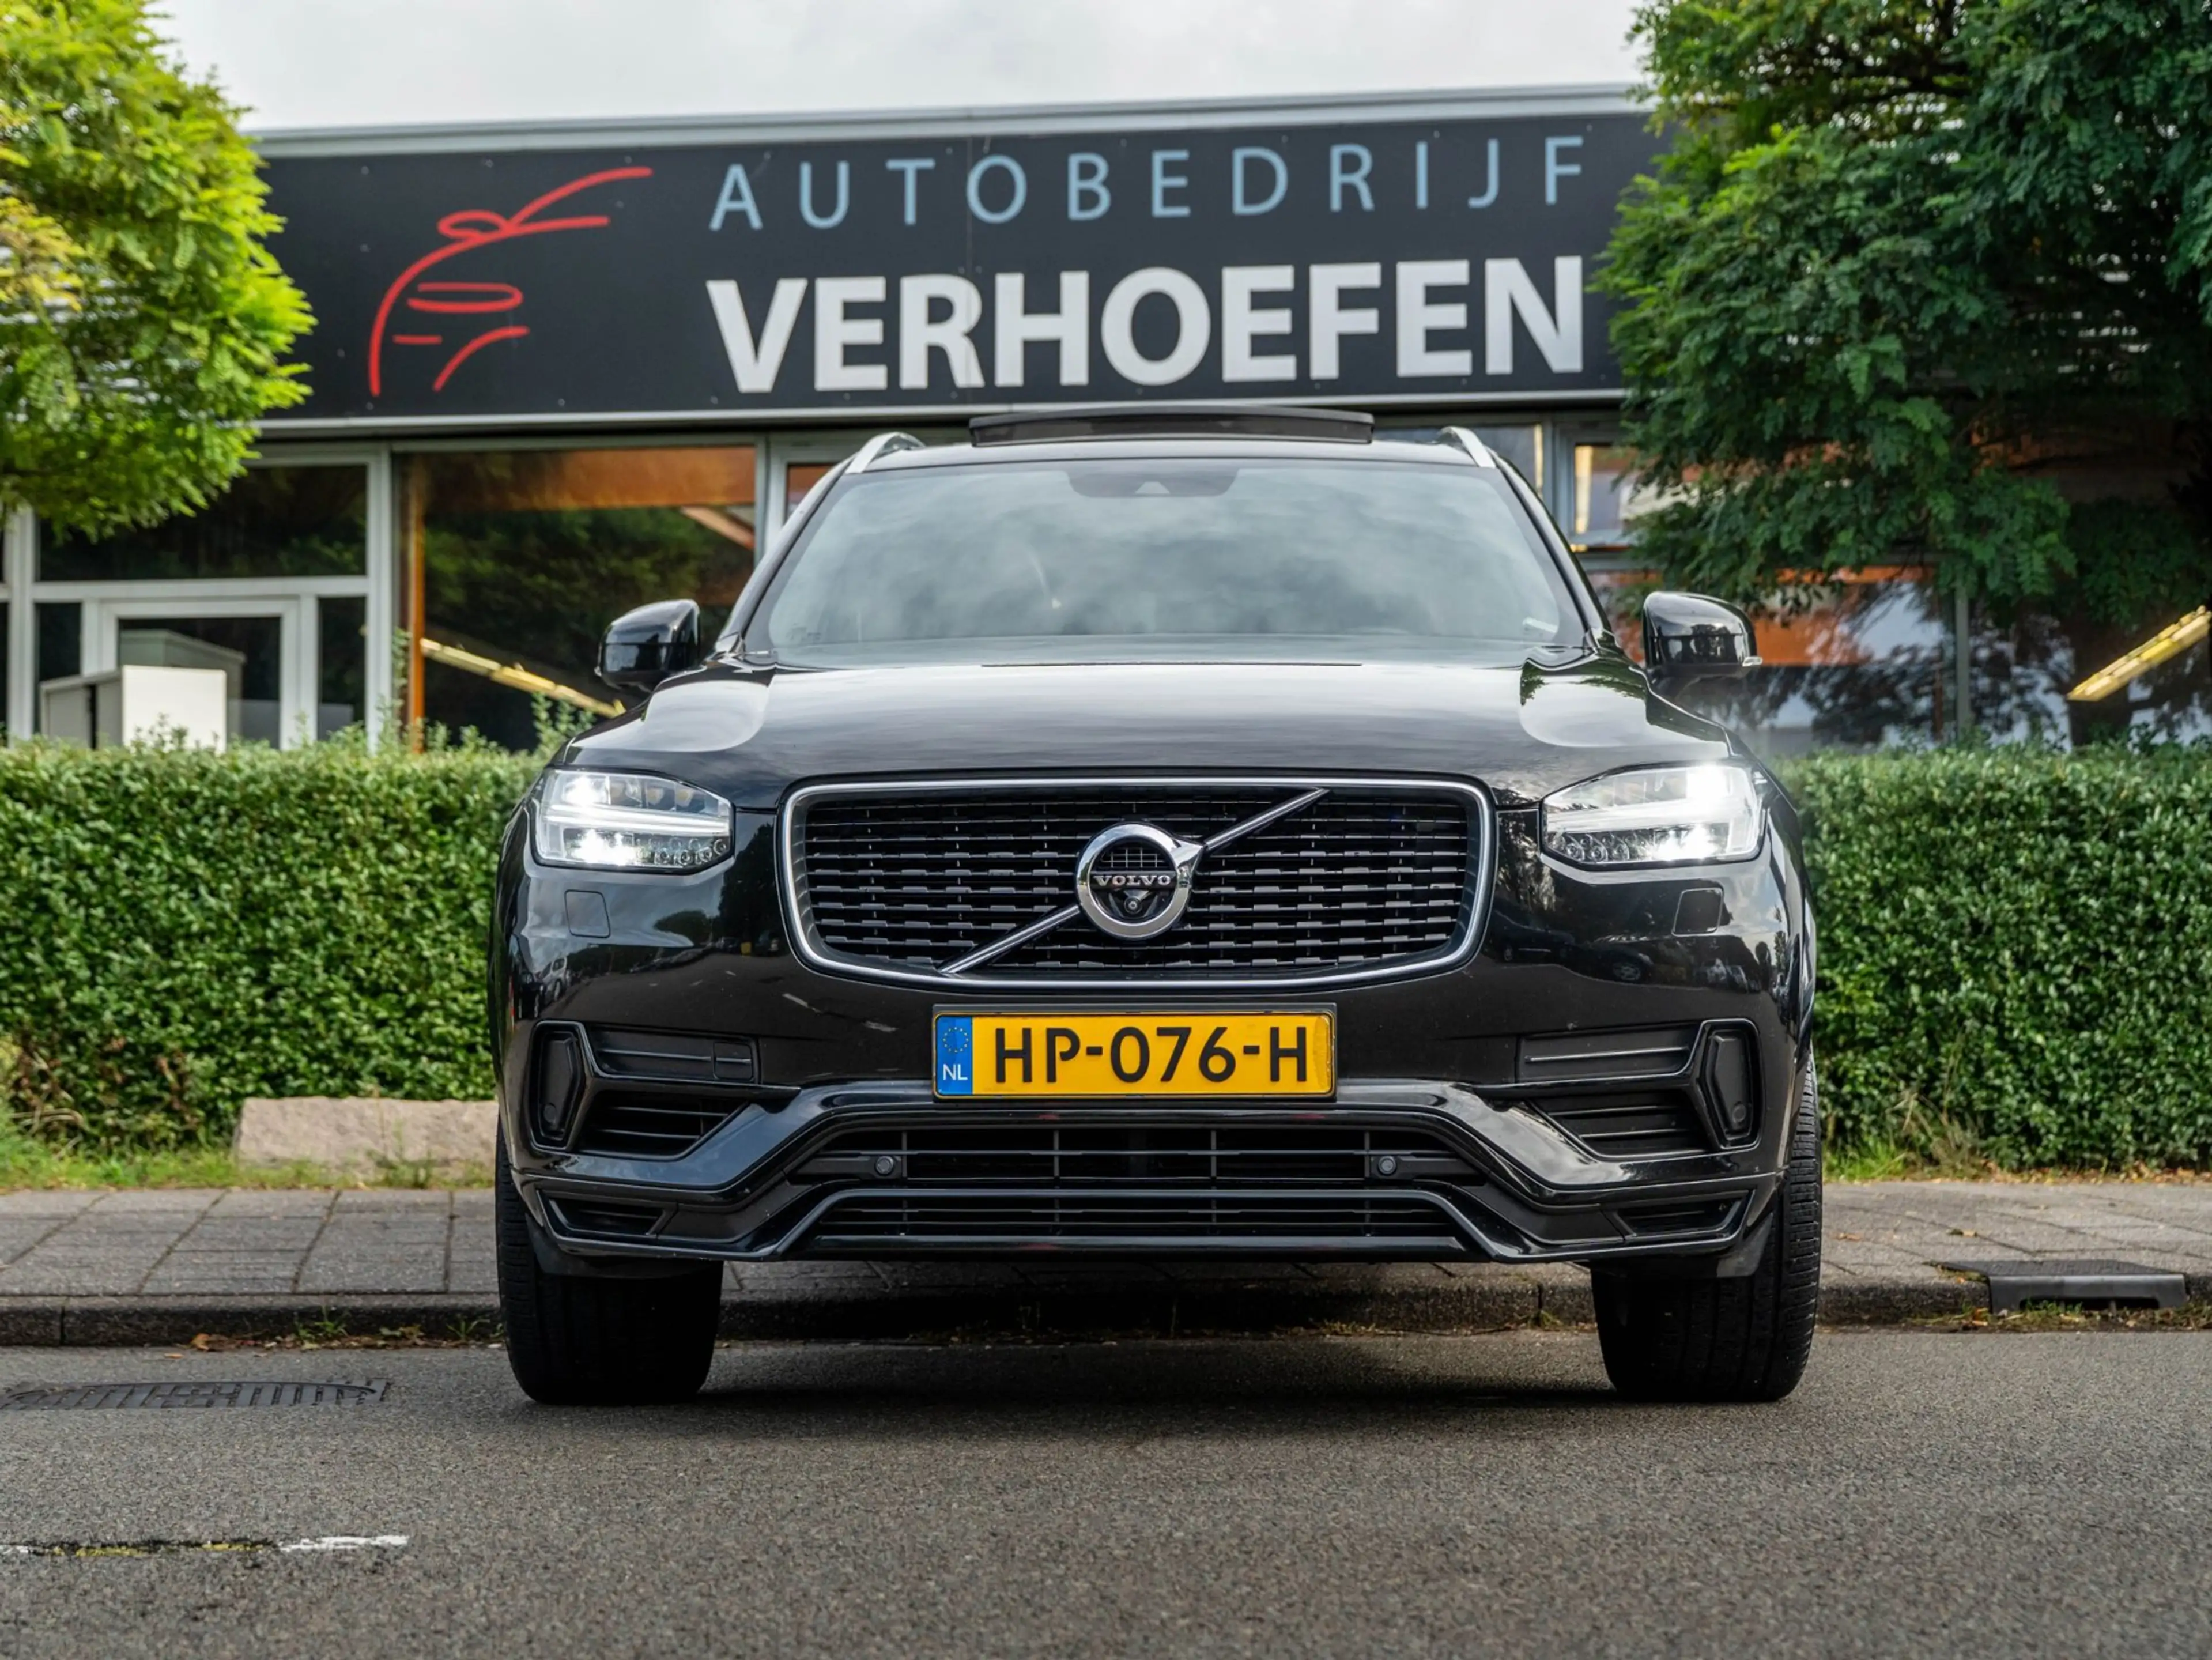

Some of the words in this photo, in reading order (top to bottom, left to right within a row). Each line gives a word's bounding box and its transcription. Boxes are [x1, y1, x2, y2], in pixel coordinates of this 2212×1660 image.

[709, 137, 1583, 231] AUTOBEDRIJF
[706, 256, 1583, 393] VERHOEFEN
[1093, 874, 1171, 886] VOLVO
[943, 1063, 968, 1080] NL
[995, 1027, 1307, 1083] HP-076-H
